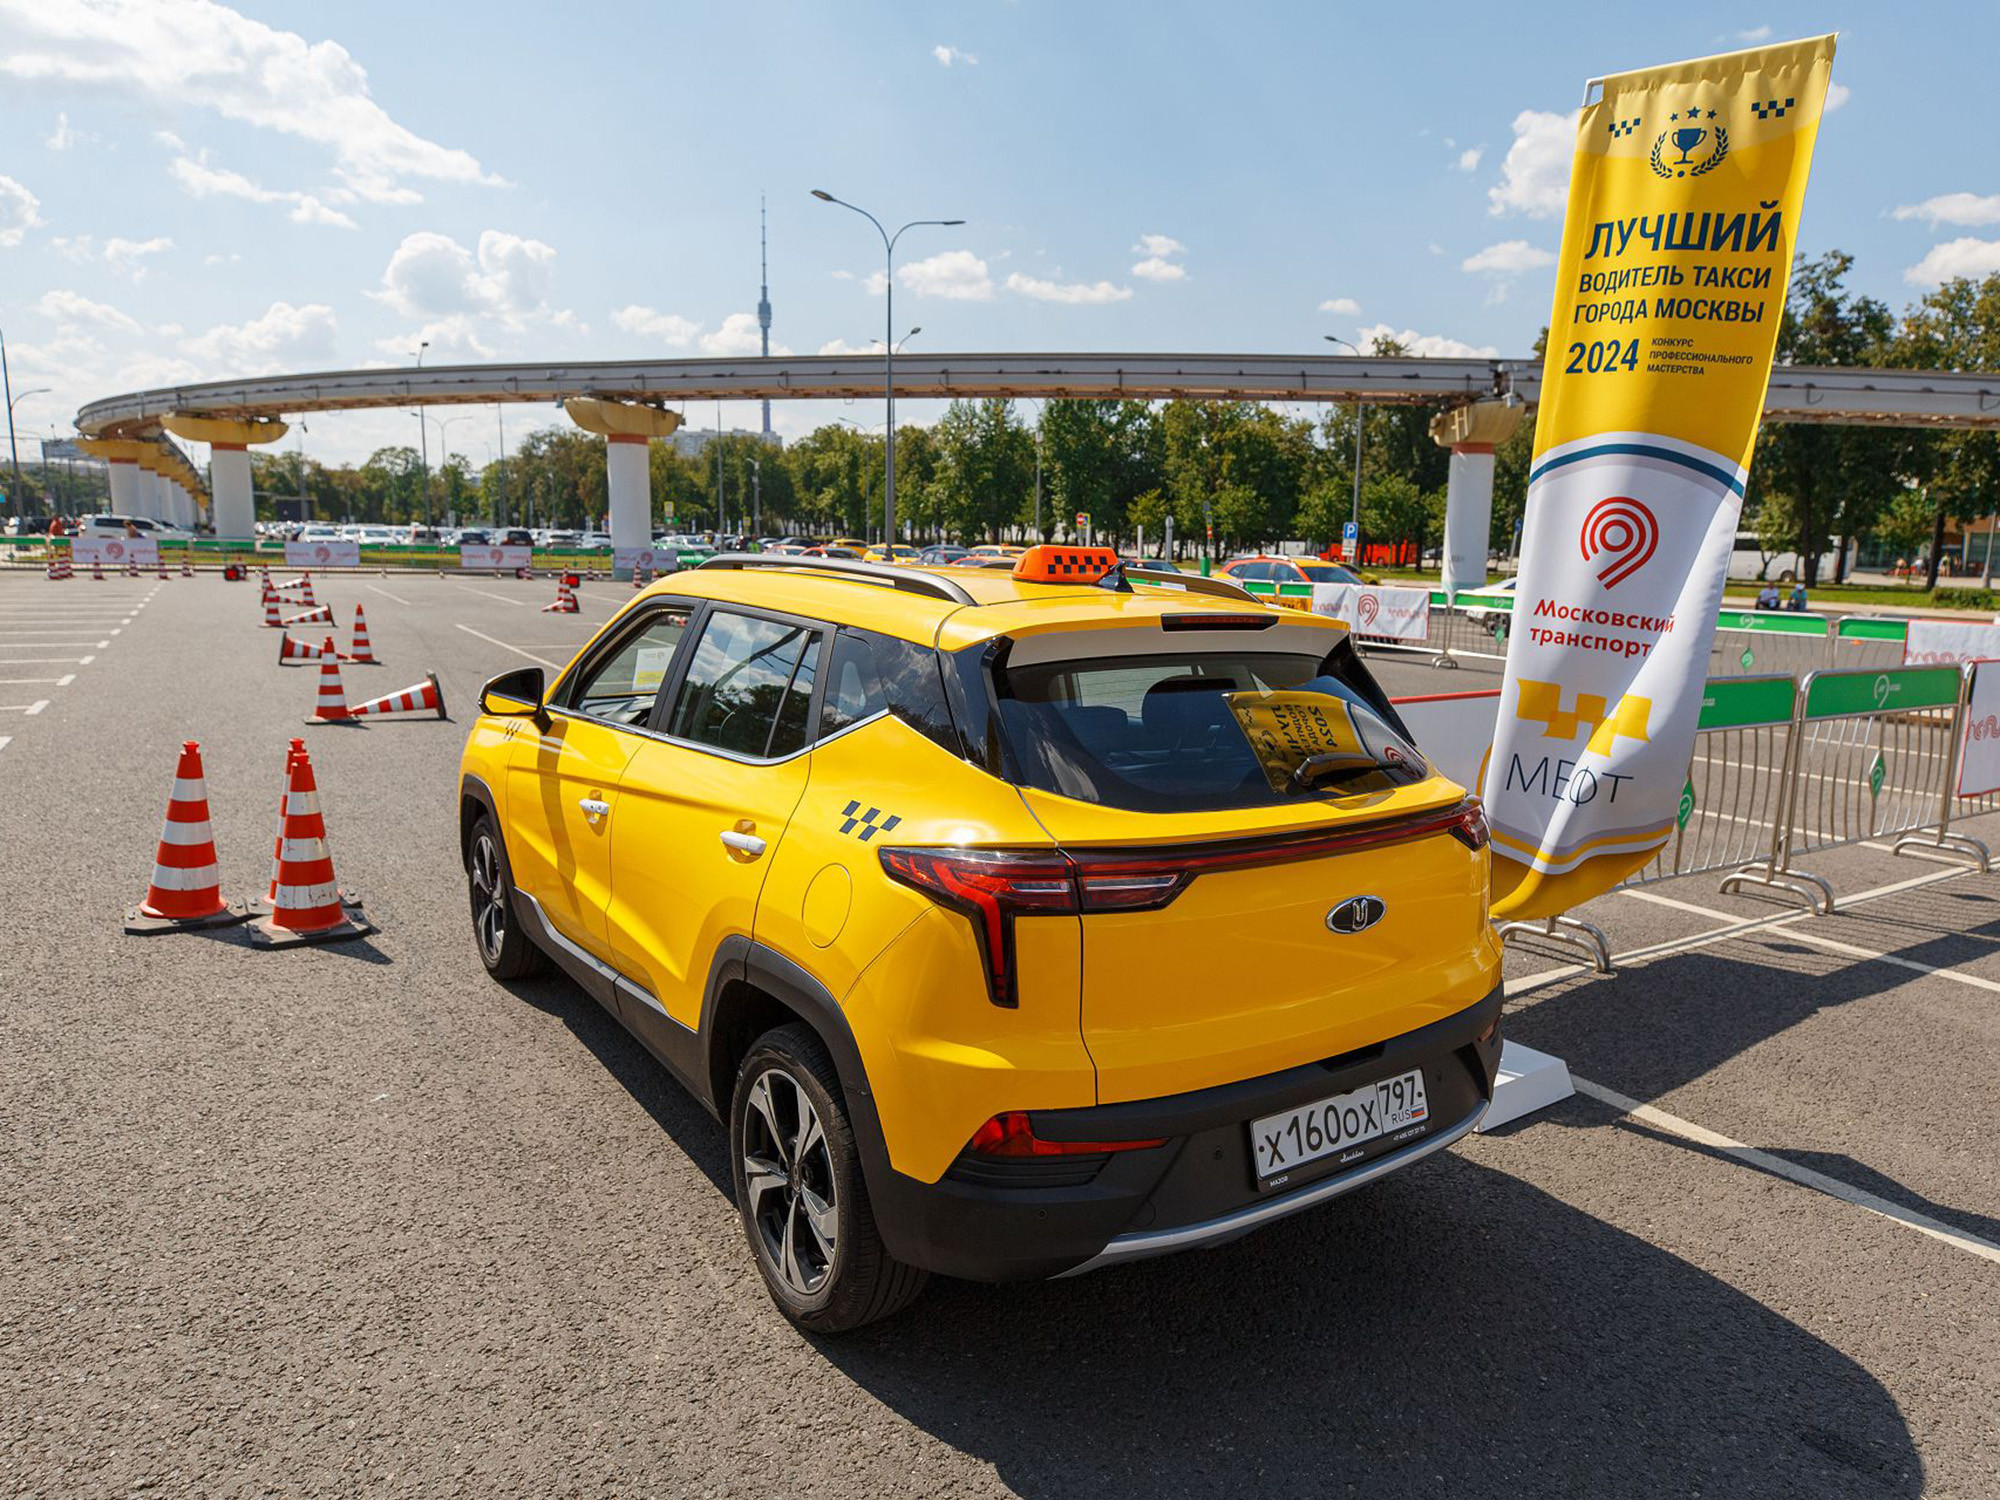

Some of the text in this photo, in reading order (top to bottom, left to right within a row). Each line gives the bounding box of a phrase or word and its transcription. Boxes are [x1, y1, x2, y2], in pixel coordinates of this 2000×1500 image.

[1585, 200, 1782, 260] ЛУЧШИЙ
[1579, 265, 1772, 295] ВОДИТЕЛЬ ТАКСИ
[1573, 298, 1765, 325] ГОРОДА МОСКВЫ
[1565, 338, 1640, 374] 2024
[1649, 350, 1754, 365] ПРОФЕССИОНАЛЬНОГО
[1651, 337, 1694, 348] КОНКУРС
[1646, 363, 1705, 375] МАСТЕРСТВА
[1533, 598, 1675, 633] Московский
[1530, 627, 1652, 658] транспорт
[1506, 753, 1634, 808] МЕФТ
[1379, 1075, 1416, 1115] 797
[1391, 1109, 1411, 1125] RUS
